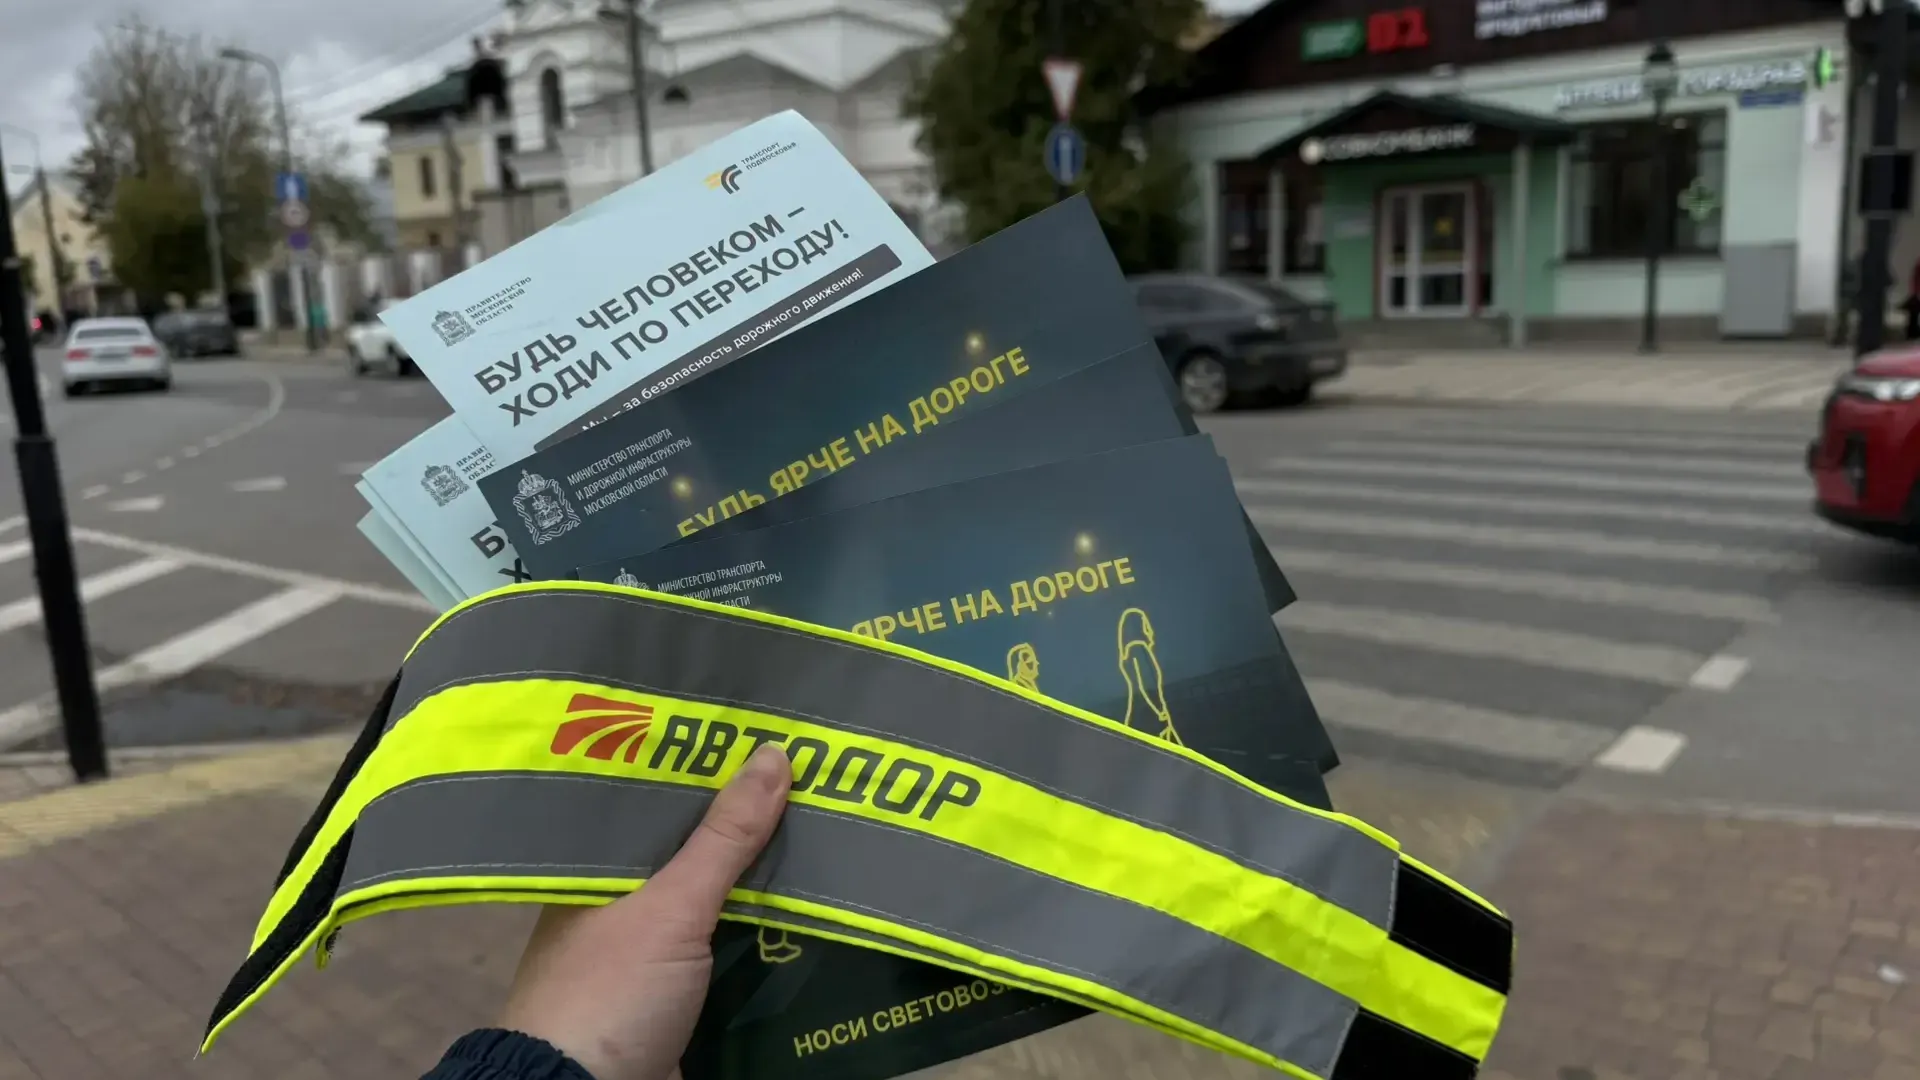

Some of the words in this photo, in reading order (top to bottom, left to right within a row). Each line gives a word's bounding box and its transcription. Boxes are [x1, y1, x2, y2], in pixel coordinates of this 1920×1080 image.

[741, 142, 780, 165] ТРАНСПОРТ
[745, 141, 797, 171] ПОДМОСКОВЬЯ
[465, 276, 532, 314] ПРАВИТЕЛЬСТВО
[470, 288, 526, 320] МОСКОВСКОЙ
[474, 332, 577, 395] БУДЬ
[576, 214, 785, 332] ЧЕЛОВЕКОМ
[475, 303, 514, 326] ОБЛАСТИ
[498, 350, 612, 427] ХОДИ
[611, 320, 669, 361] ПО
[669, 219, 850, 328] ПЕРЕХОДУ!
[623, 397, 641, 411] за
[641, 343, 733, 400] безопасность
[733, 304, 801, 349] дорожного
[802, 267, 864, 311] движения!
[769, 436, 856, 497] ЯРЧЕ
[854, 413, 907, 454] НА
[908, 346, 1030, 434] ДОРОГЕ
[567, 449, 628, 486] МИНИСТЕРСТВО
[626, 428, 673, 457] ТРАНСПОРТА
[575, 490, 585, 501] И
[583, 467, 628, 499] ДОРОЖНОЙ
[626, 437, 692, 476] ИНФРАСТРУКТУРЫ
[584, 481, 636, 516] МОСКОВСКОЙ
[634, 466, 669, 490] ОБЛАСТИ
[657, 571, 717, 593] МИНИСТЕРСТВО
[716, 560, 766, 580] ТРАНСПОРТА
[711, 572, 783, 598] ИНФРАСТРУКТУРЫ
[851, 601, 947, 641] ЯРЧЕ
[950, 589, 1004, 624] НА
[1010, 557, 1136, 616] ДОРОГЕ
[648, 714, 982, 822] АВТОДОР
[793, 1016, 868, 1058] НОСИ
[872, 979, 1013, 1032] СВЕТОВОЗ
